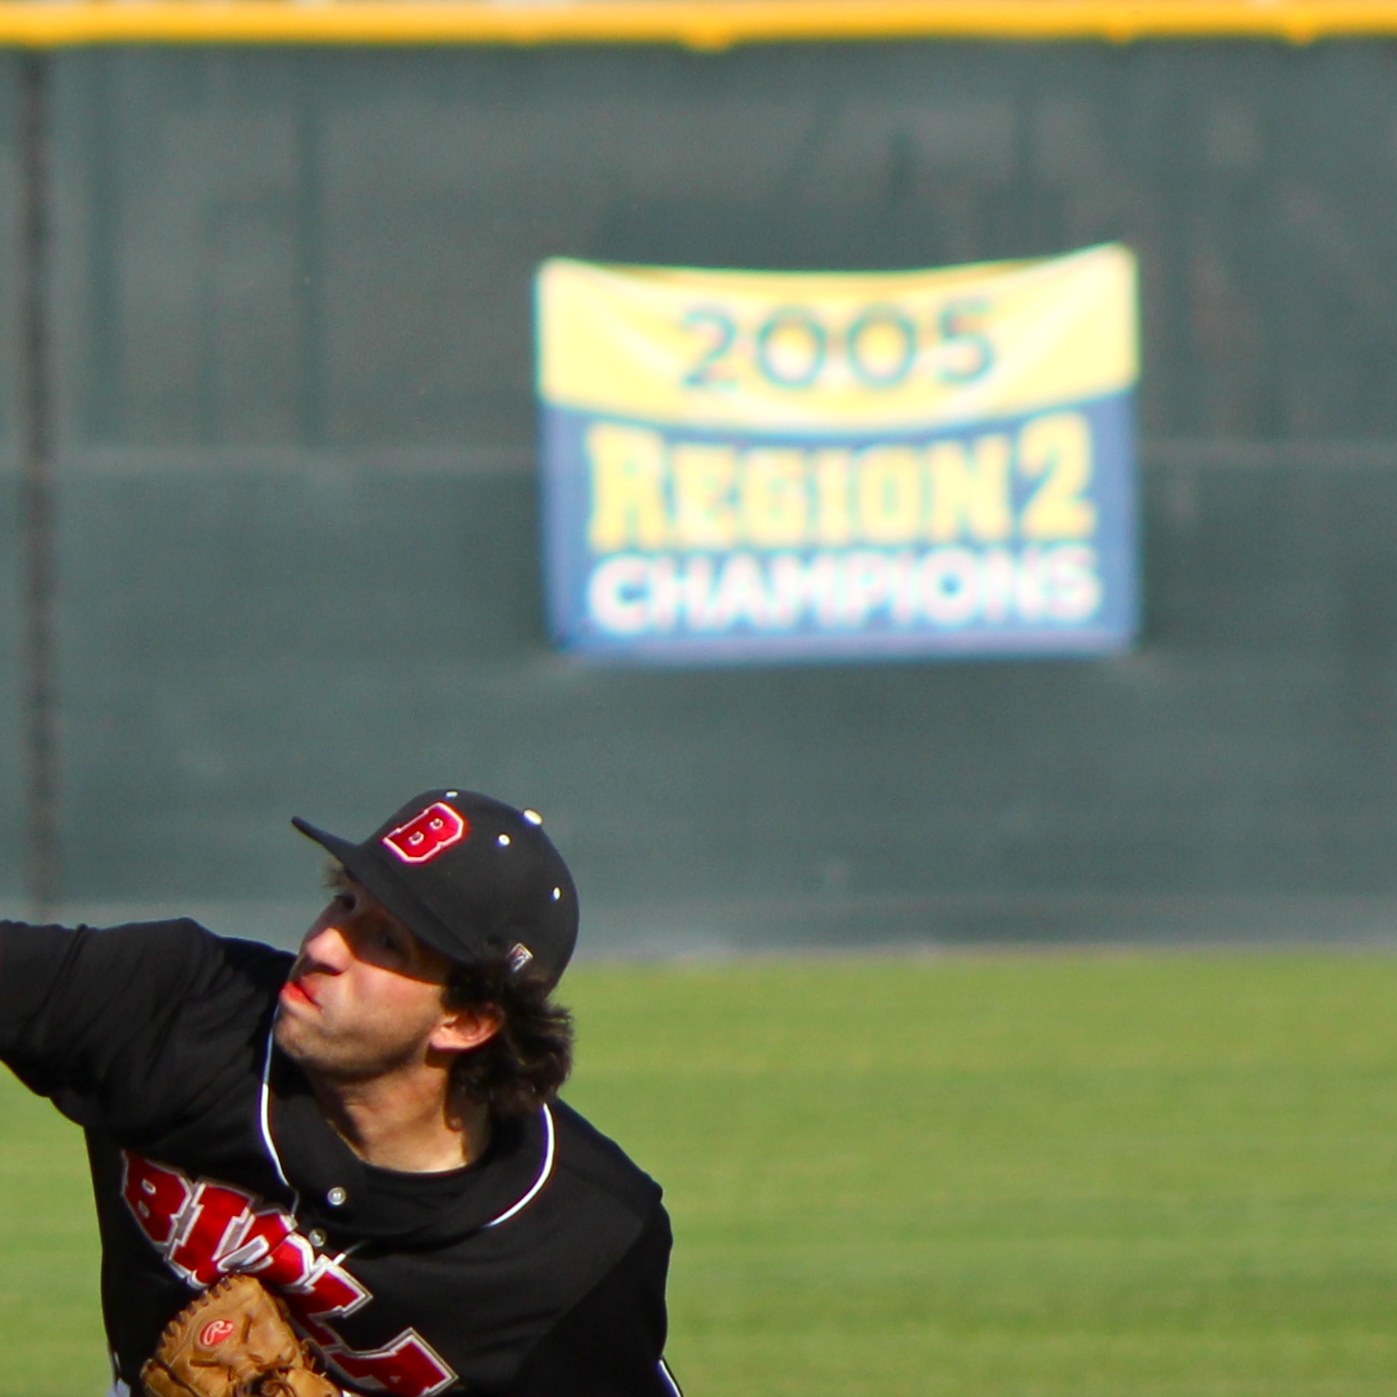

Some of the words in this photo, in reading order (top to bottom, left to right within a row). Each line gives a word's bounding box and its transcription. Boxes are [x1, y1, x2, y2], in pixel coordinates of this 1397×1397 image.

[680, 299, 995, 392] 2005
[587, 421, 1012, 552] REGION
[1017, 411, 1095, 543] 2
[589, 543, 1102, 632] CHAMPIONS
[381, 801, 464, 862] B
